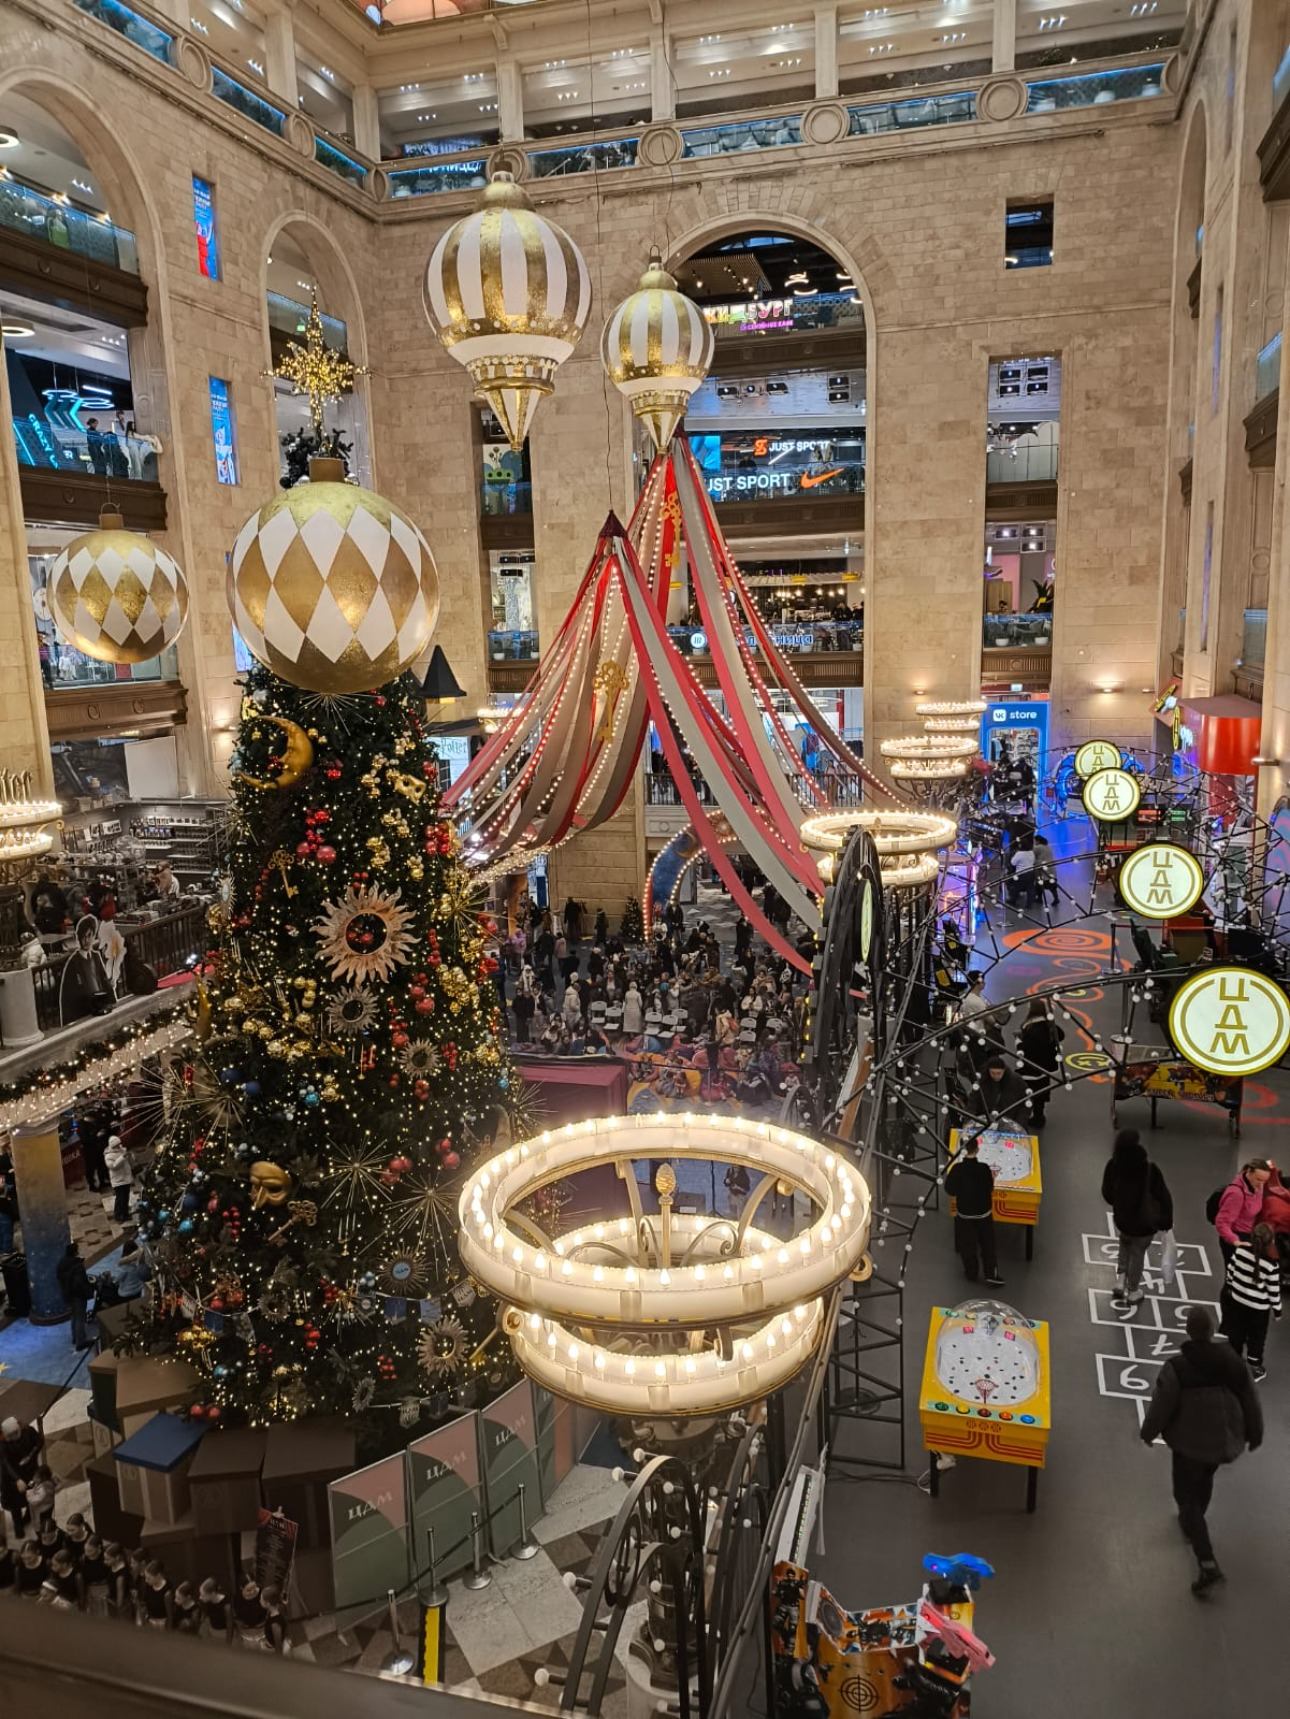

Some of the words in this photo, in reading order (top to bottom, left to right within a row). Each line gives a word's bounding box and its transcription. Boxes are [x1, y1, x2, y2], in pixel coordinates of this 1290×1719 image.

[736, 473, 790, 491] SPORT
[1009, 711, 1038, 719] store
[1103, 774, 1120, 810] ЦДМ
[1147, 852, 1173, 905] ЦДМ
[1210, 977, 1250, 1055] ЦДМ
